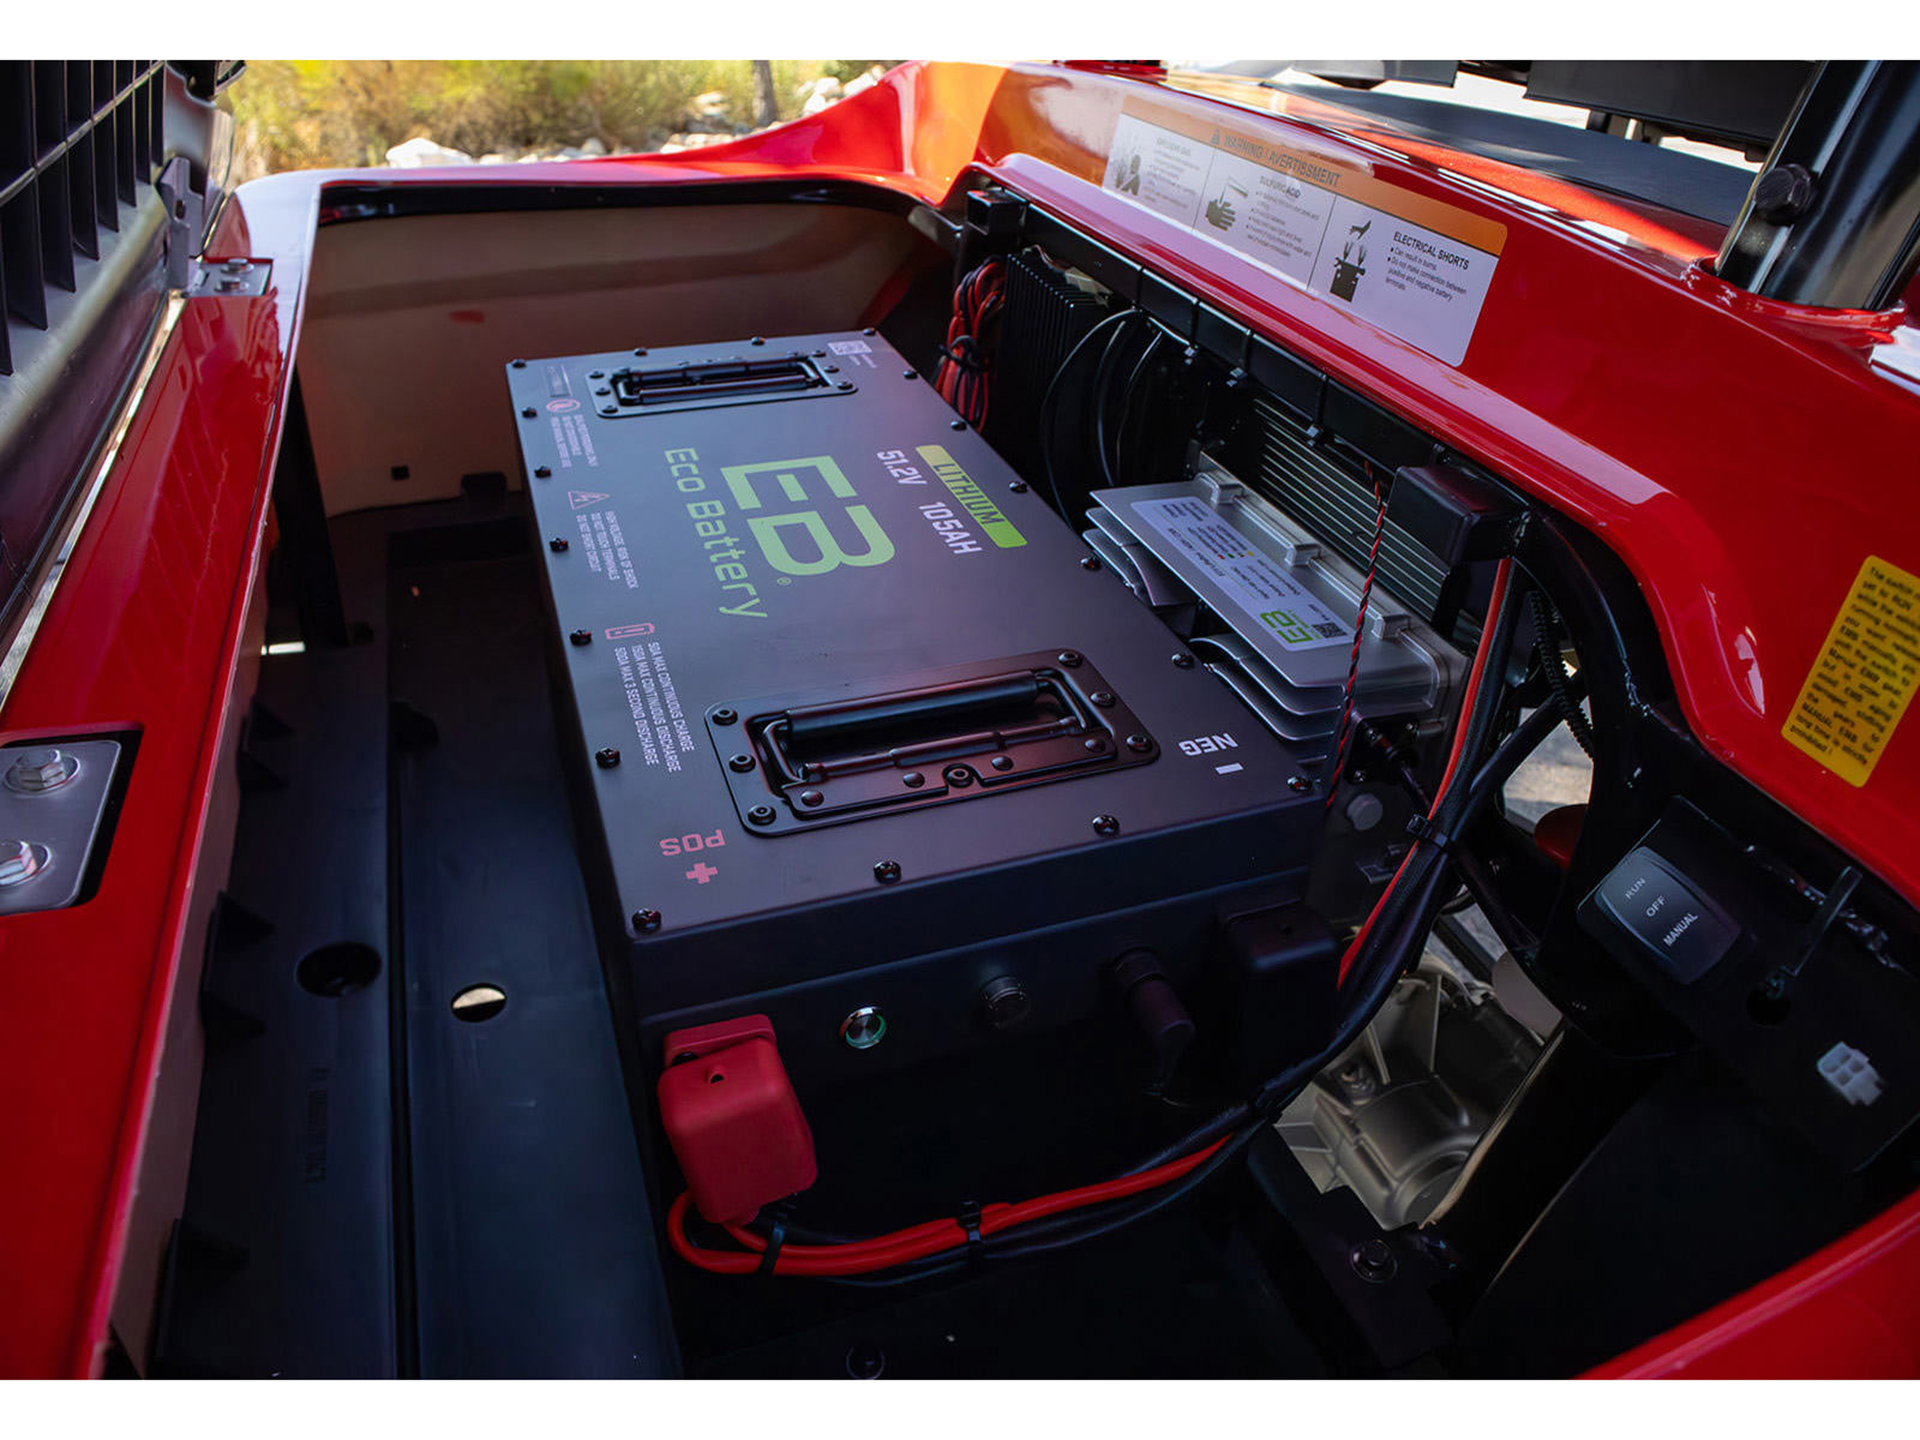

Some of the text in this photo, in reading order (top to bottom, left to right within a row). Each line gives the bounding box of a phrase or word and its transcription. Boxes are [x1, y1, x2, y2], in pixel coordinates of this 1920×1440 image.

[1224, 135, 1263, 159] WARNING
[1269, 151, 1342, 187] AVERTISSMENT
[1287, 187, 1301, 198] ACID
[1394, 231, 1469, 270] ELECTRICAL SHORTS
[1395, 247, 1403, 255] Can
[877, 450, 982, 554] 51.2V 105AH
[932, 463, 1006, 525] LITHIUM
[1260, 610, 1313, 644] EB
[621, 666, 635, 682] MAX
[637, 661, 650, 678] MAX
[653, 656, 666, 672] MAX
[627, 689, 645, 719] SECOND
[642, 678, 666, 725] CONTINUOUS
[658, 673, 683, 719] CONTINUOUS
[635, 719, 659, 765] DISCHARGE
[656, 726, 681, 772] DISCHARGE
[673, 719, 694, 752] CHARGE
[1179, 733, 1238, 756] NEG
[659, 829, 725, 856] POS
[1625, 878, 1647, 900] RUN
[1646, 895, 1666, 917] OFF
[1663, 913, 1698, 946] MANUAL
